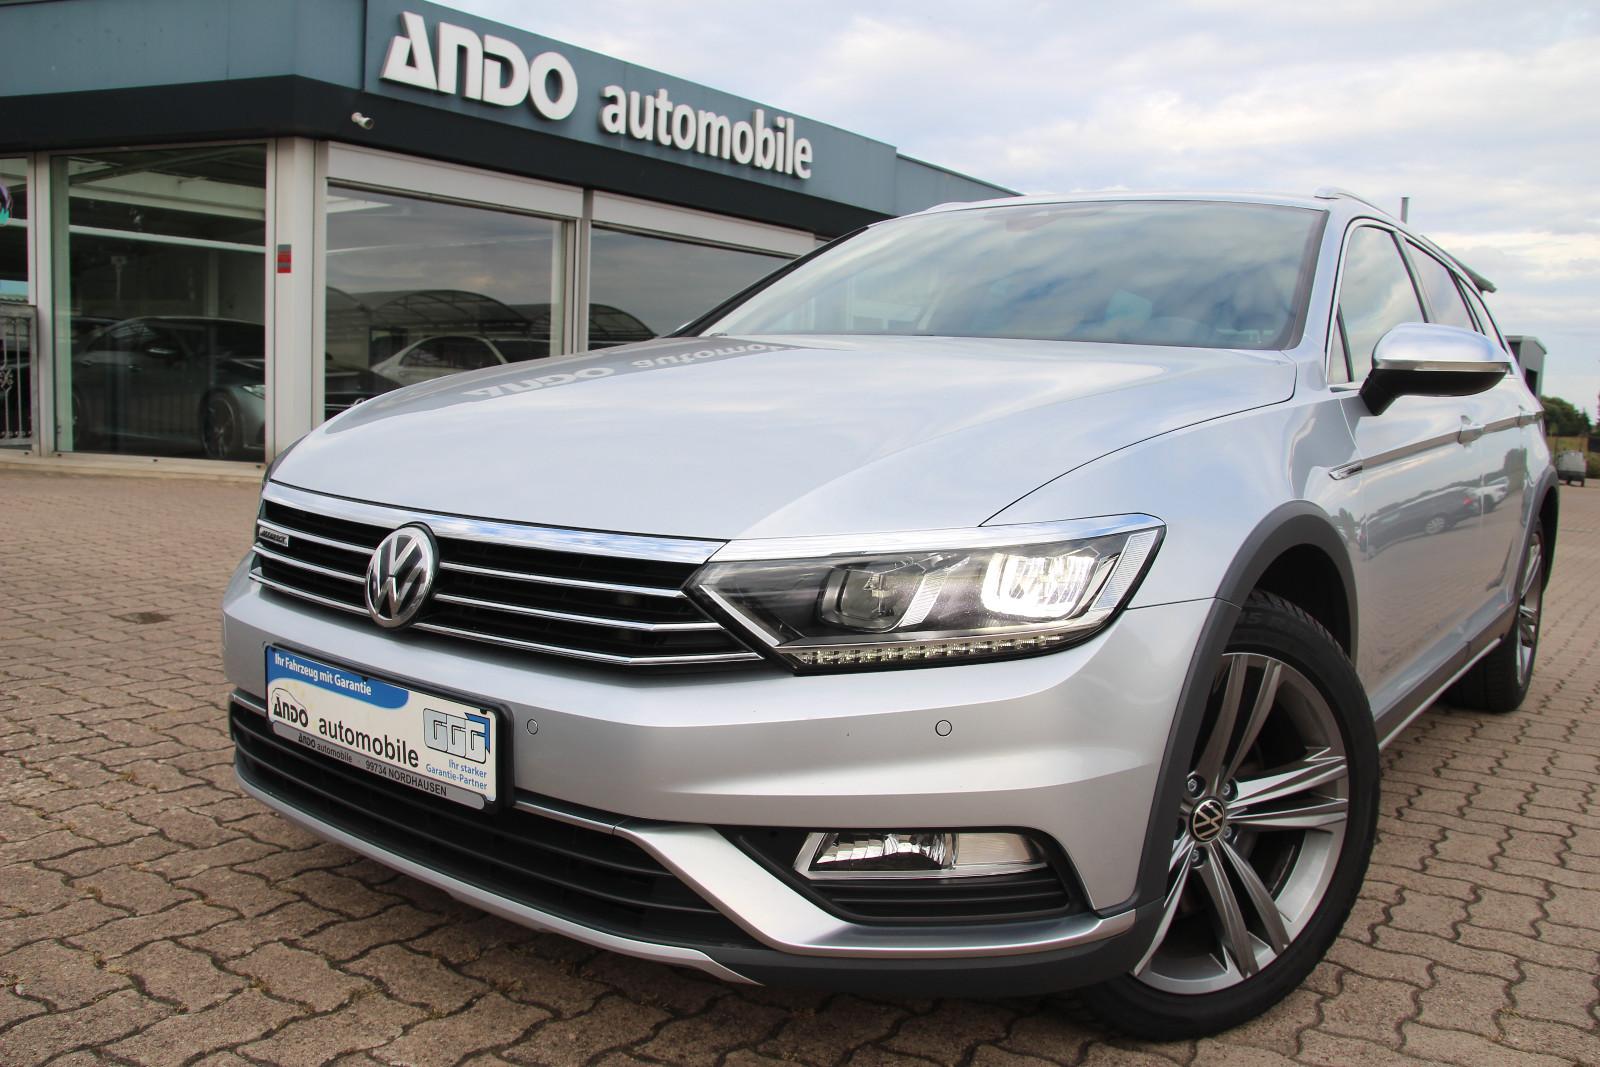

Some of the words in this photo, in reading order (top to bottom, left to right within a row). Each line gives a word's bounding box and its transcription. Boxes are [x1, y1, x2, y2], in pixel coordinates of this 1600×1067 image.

[380, 11, 578, 120] ANDO
[602, 84, 814, 180] automobile
[274, 653, 284, 667] Ihr
[285, 657, 318, 681] Fahrzeug
[320, 671, 333, 683] mit
[334, 674, 372, 696] Garantie
[273, 696, 309, 728] ANDO
[319, 717, 419, 768] automobile
[298, 734, 316, 748] ANDO
[317, 742, 353, 762] automobile
[365, 760, 387, 775] 99734
[388, 768, 447, 797] NORDHAUSEN
[426, 763, 488, 790] Garantie-Partner
[448, 760, 459, 769] Ihr
[460, 764, 487, 779] starker
